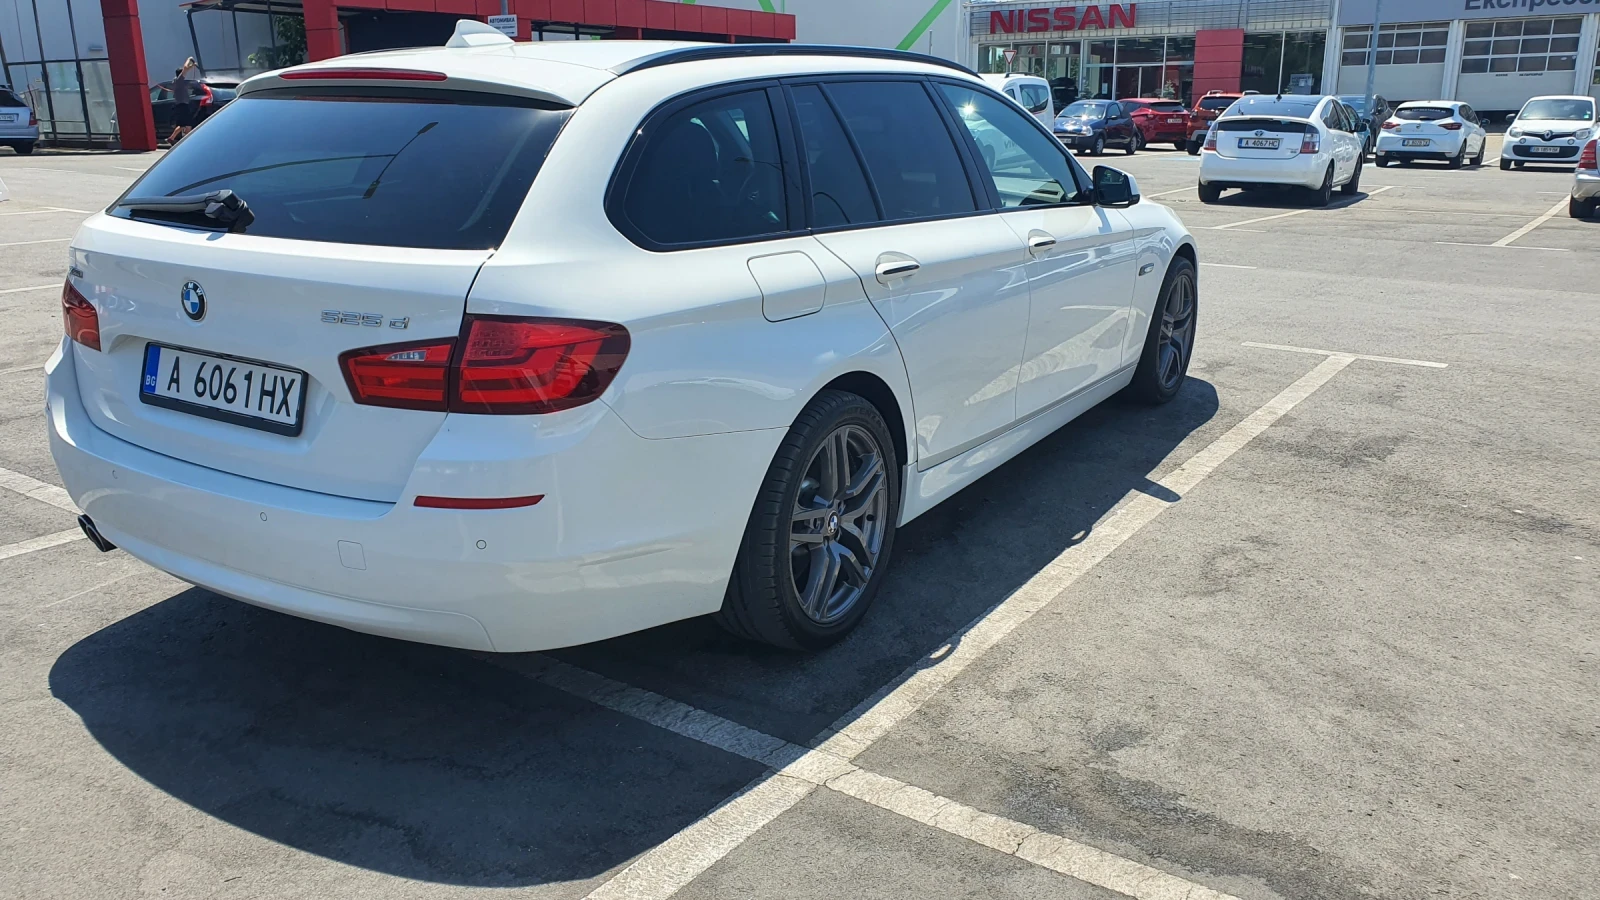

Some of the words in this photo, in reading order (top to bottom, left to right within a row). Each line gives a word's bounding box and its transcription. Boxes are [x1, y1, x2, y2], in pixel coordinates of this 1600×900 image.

[990, 3, 1136, 34] NISSAN
[320, 309, 384, 328] 525
[388, 316, 410, 330] d
[145, 375, 156, 387] BG
[167, 356, 180, 393] A
